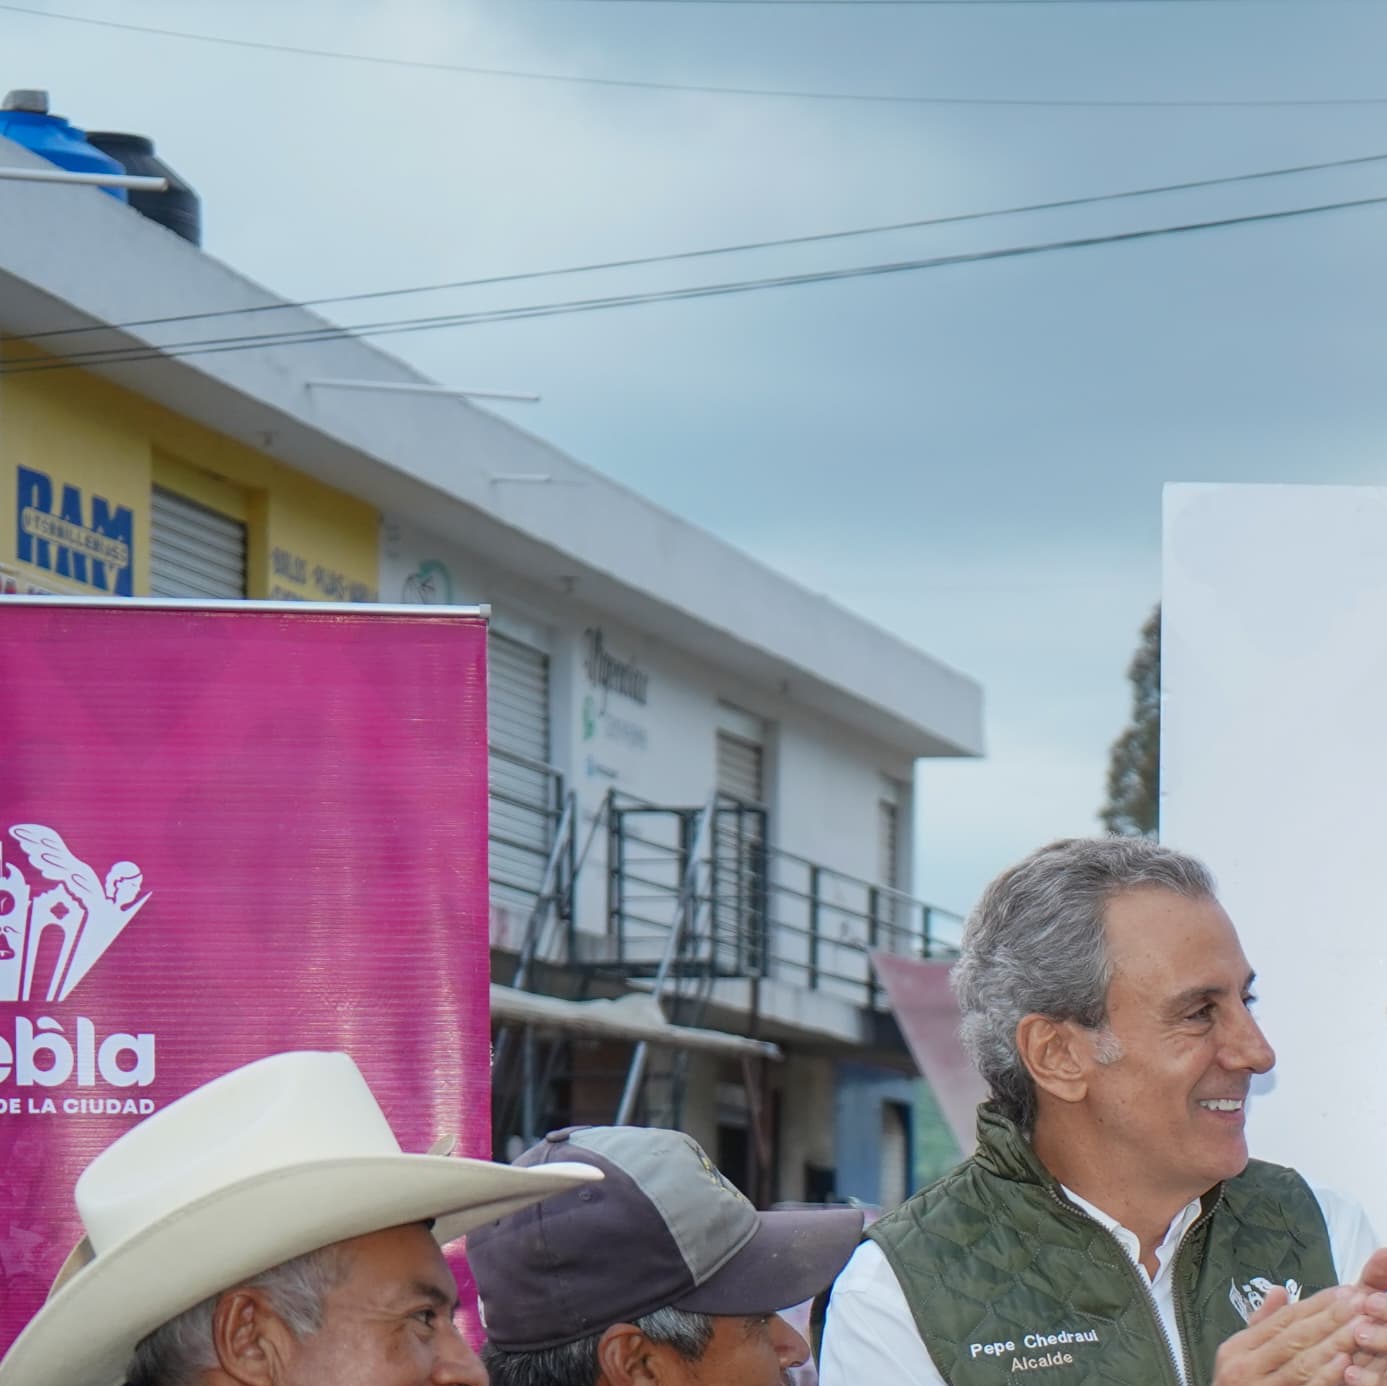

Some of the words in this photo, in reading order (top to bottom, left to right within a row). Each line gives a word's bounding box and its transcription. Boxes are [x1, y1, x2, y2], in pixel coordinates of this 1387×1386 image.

[16, 463, 133, 597] RAM
[28, 1097, 57, 1115] LA
[63, 1098, 155, 1115] CIUDAD
[970, 1341, 1015, 1358] Pepe
[1011, 1351, 1073, 1373] Alcalde
